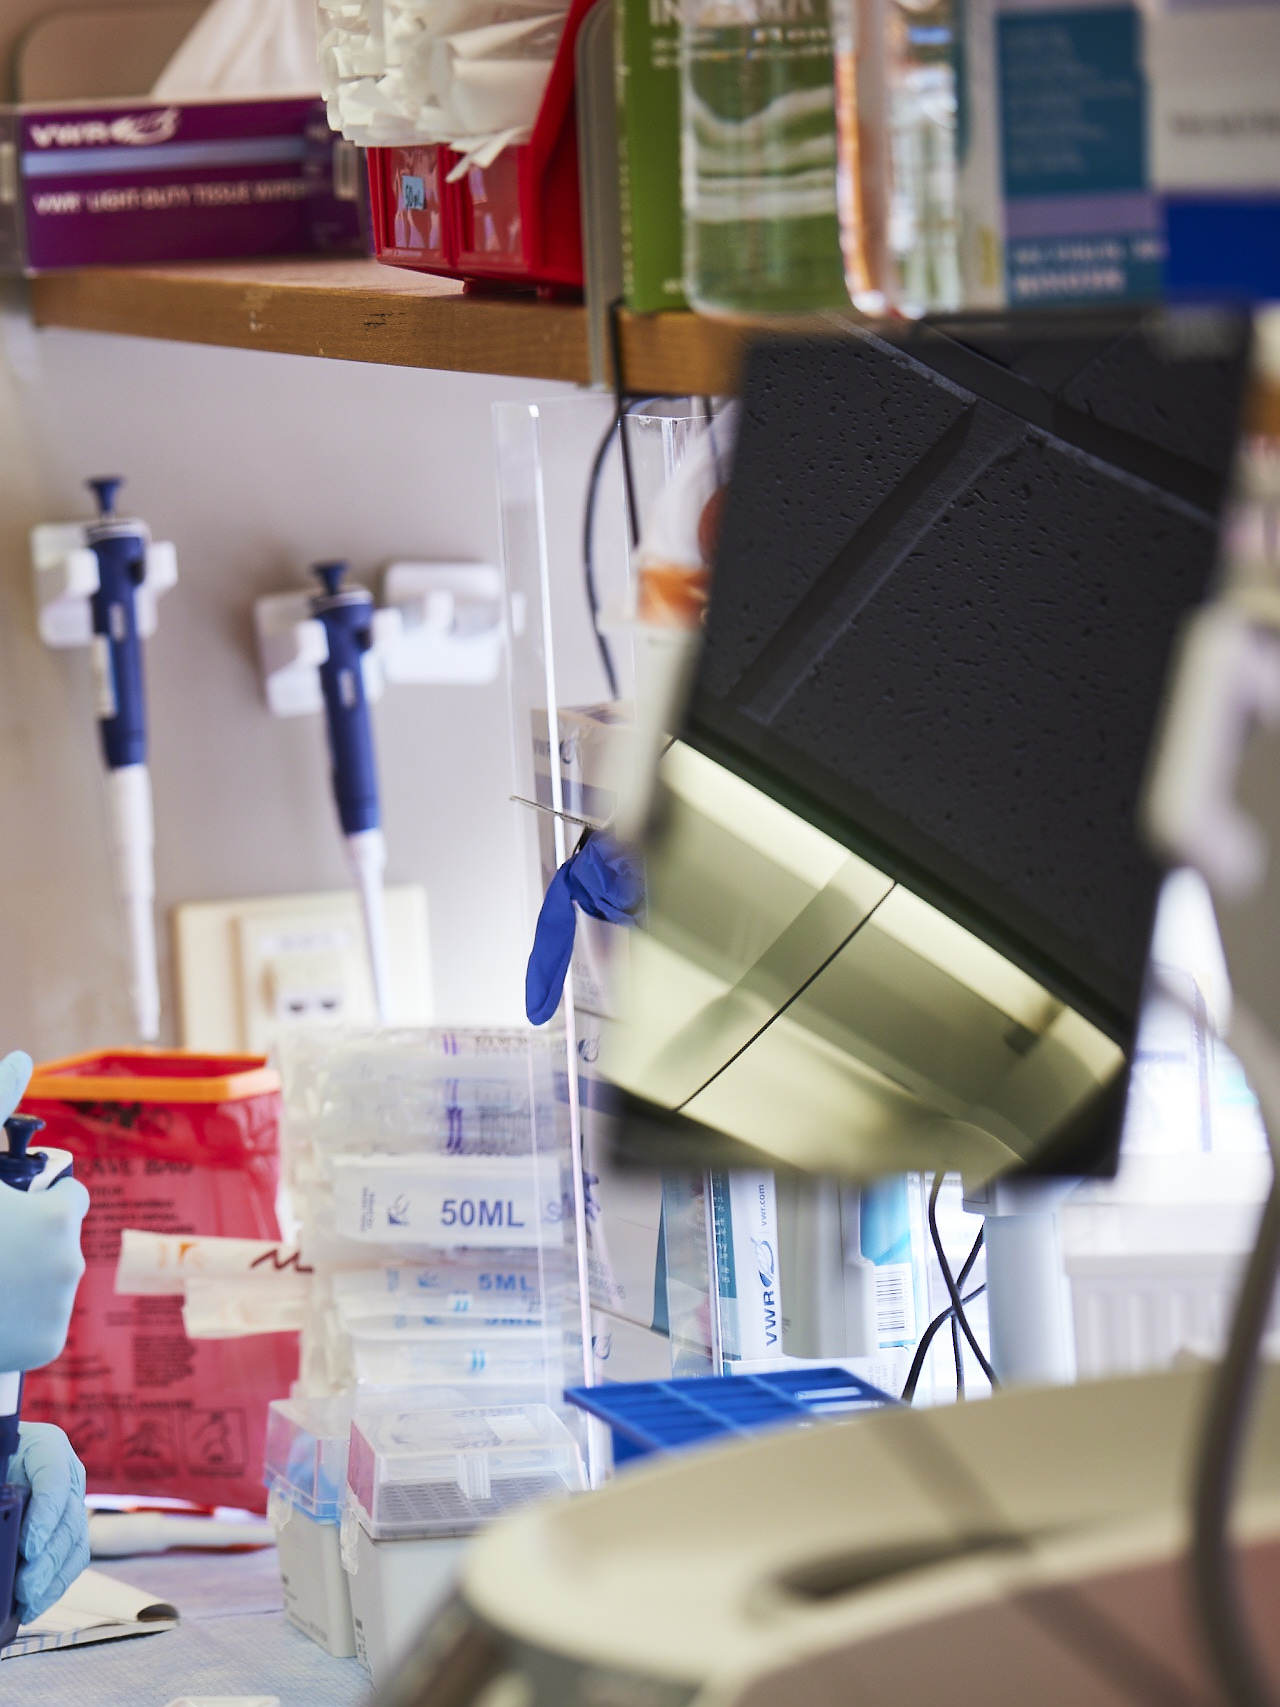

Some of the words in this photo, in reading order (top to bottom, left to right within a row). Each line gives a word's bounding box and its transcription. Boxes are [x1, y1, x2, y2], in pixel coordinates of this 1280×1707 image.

[29, 120, 108, 148] VWR
[440, 1199, 525, 1228] 50ML
[757, 1183, 768, 1227] vwr.com
[478, 1272, 536, 1293] 5ML
[762, 1290, 778, 1347] VWR
